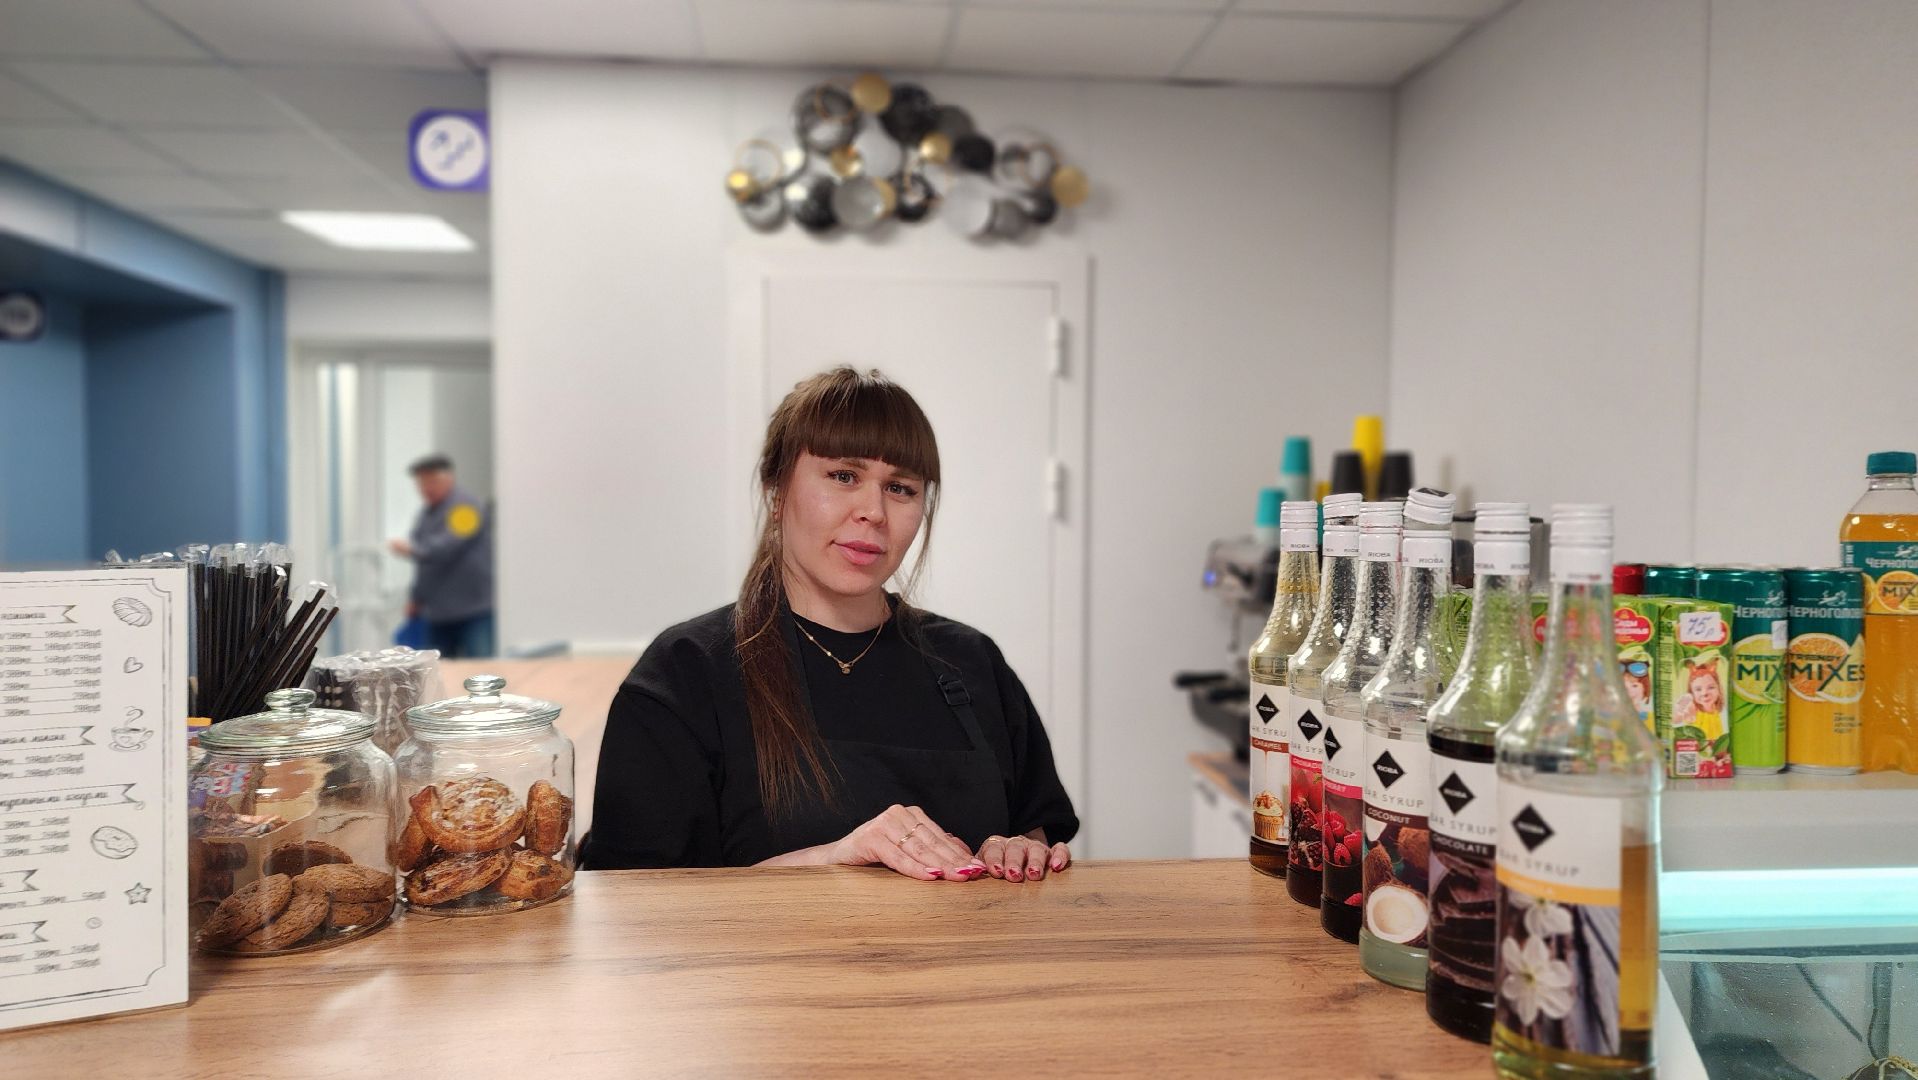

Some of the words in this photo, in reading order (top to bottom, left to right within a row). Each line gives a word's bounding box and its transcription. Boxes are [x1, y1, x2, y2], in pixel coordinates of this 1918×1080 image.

[1382, 793, 1425, 808] SYRUP
[1366, 807, 1411, 824] COCONUT
[1450, 820, 1497, 835] SYRUP
